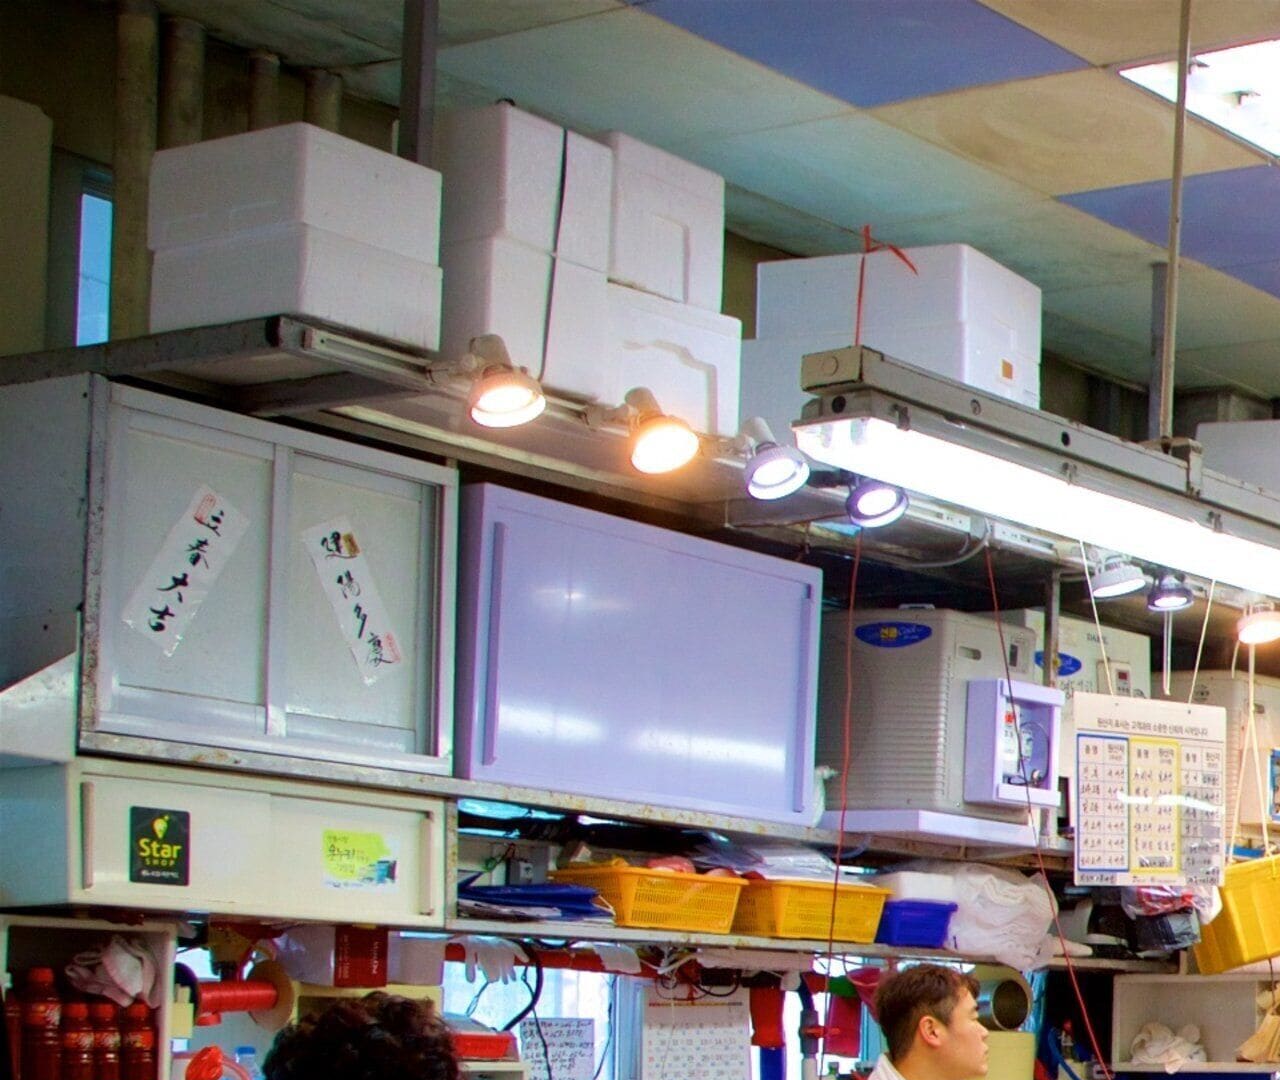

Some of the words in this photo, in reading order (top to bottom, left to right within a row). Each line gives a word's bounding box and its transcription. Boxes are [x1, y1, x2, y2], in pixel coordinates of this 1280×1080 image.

[149, 509, 225, 633] 立春大吉
[138, 837, 182, 859] Star
